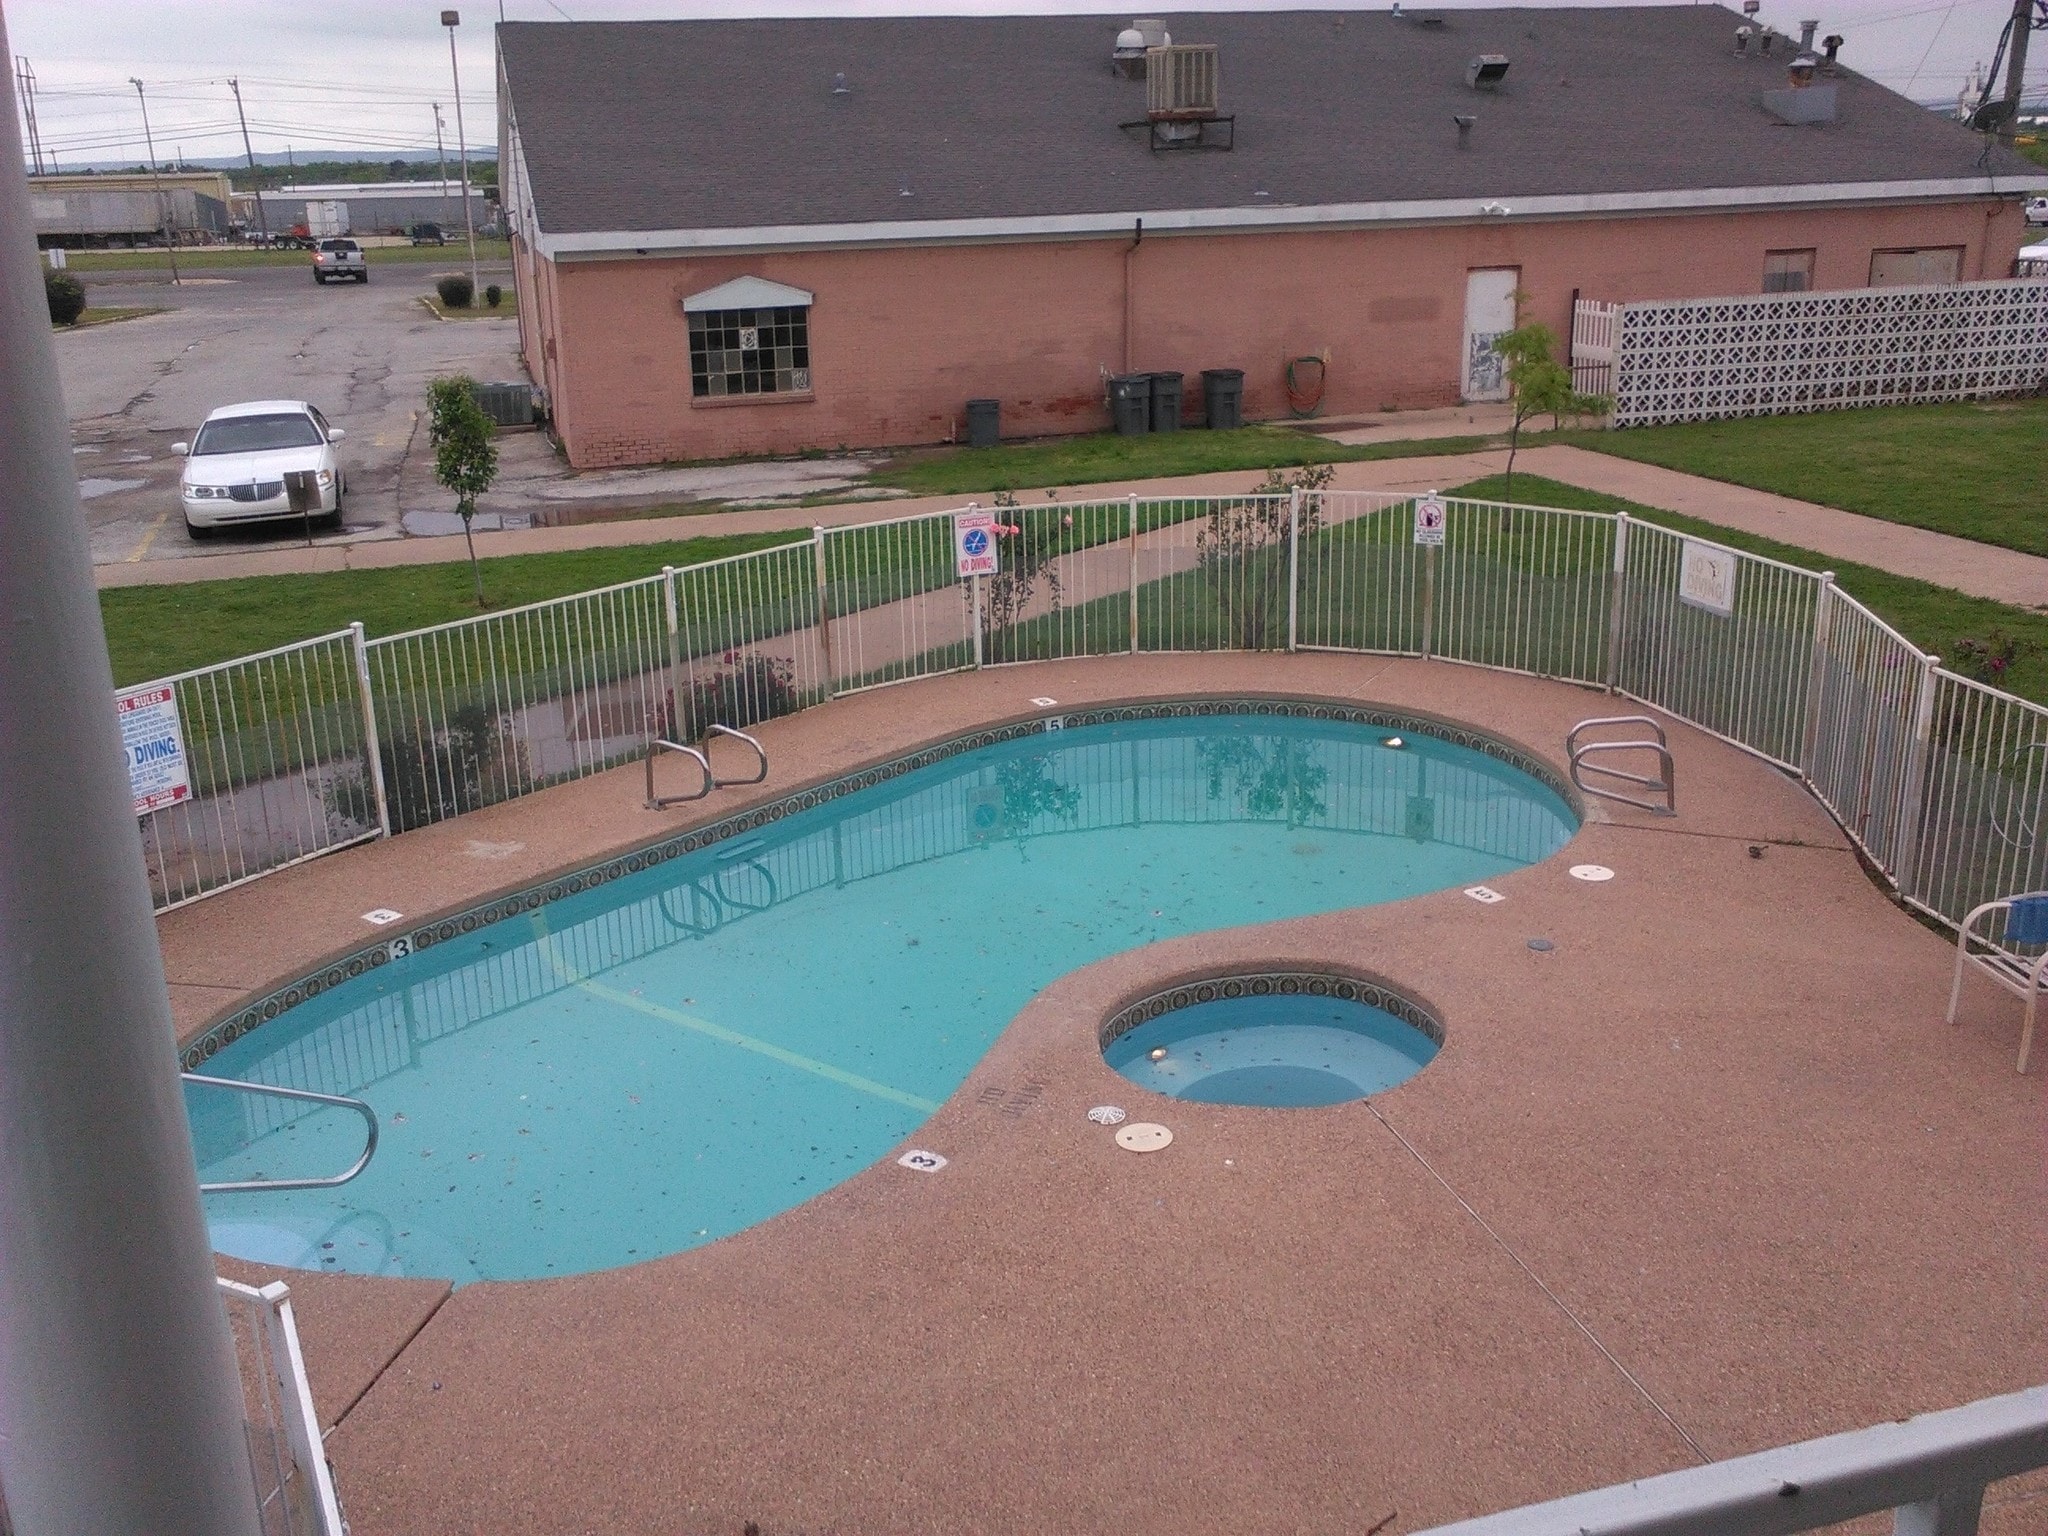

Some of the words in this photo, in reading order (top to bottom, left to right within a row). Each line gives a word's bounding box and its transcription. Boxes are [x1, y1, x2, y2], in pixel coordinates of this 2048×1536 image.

[960, 558, 969, 573] NO
[117, 699, 131, 713] OL
[132, 691, 164, 710] RULES
[1050, 719, 1060, 731] 5
[134, 736, 181, 765] DIVING.
[393, 938, 410, 959] 3
[910, 1155, 937, 1168] 3
